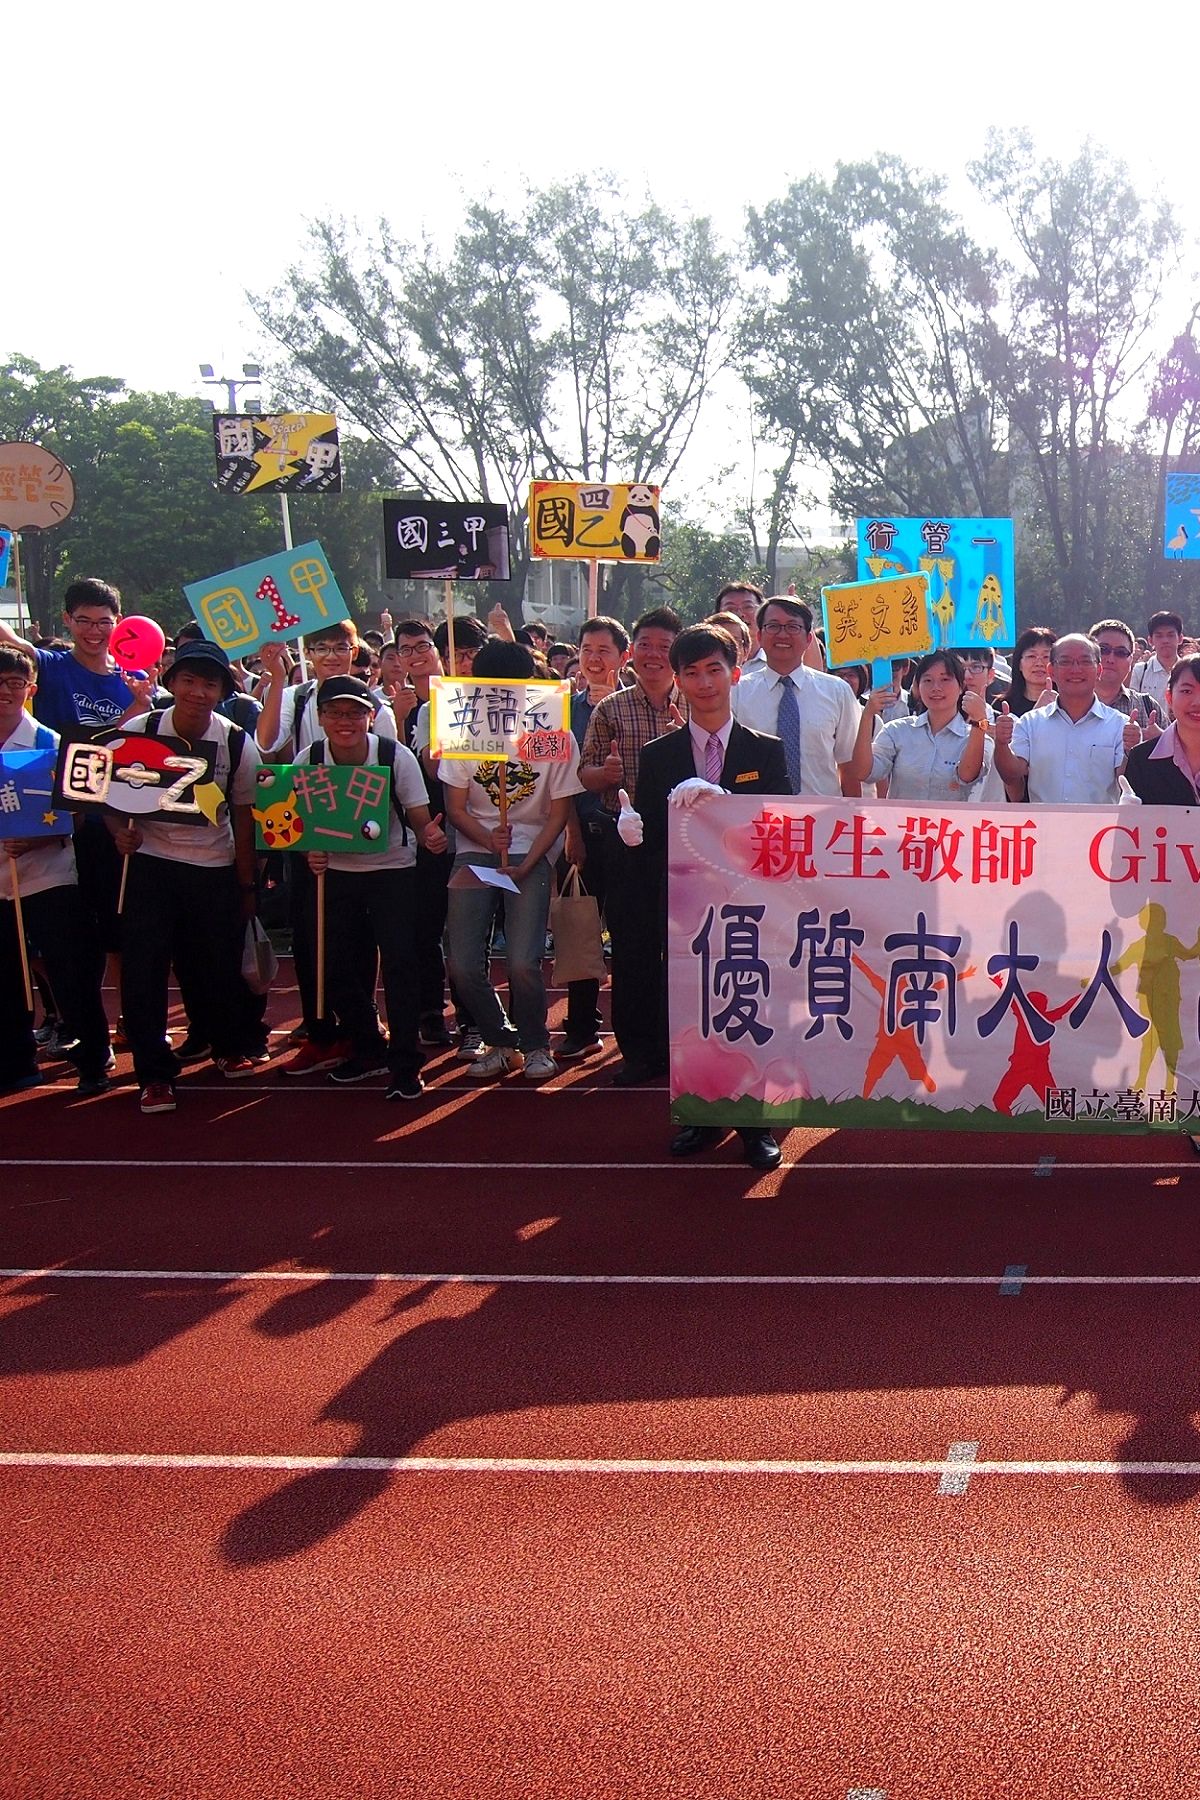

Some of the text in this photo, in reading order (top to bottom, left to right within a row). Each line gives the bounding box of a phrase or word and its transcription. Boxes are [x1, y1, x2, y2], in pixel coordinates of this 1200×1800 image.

[397, 515, 488, 553] 國三甲
[864, 520, 996, 555] 行管一
[448, 687, 553, 738] 英語系
[439, 738, 505, 752] ENGLISH
[750, 811, 1037, 885] 親生敬師
[690, 903, 1151, 1047] 優質南大人
